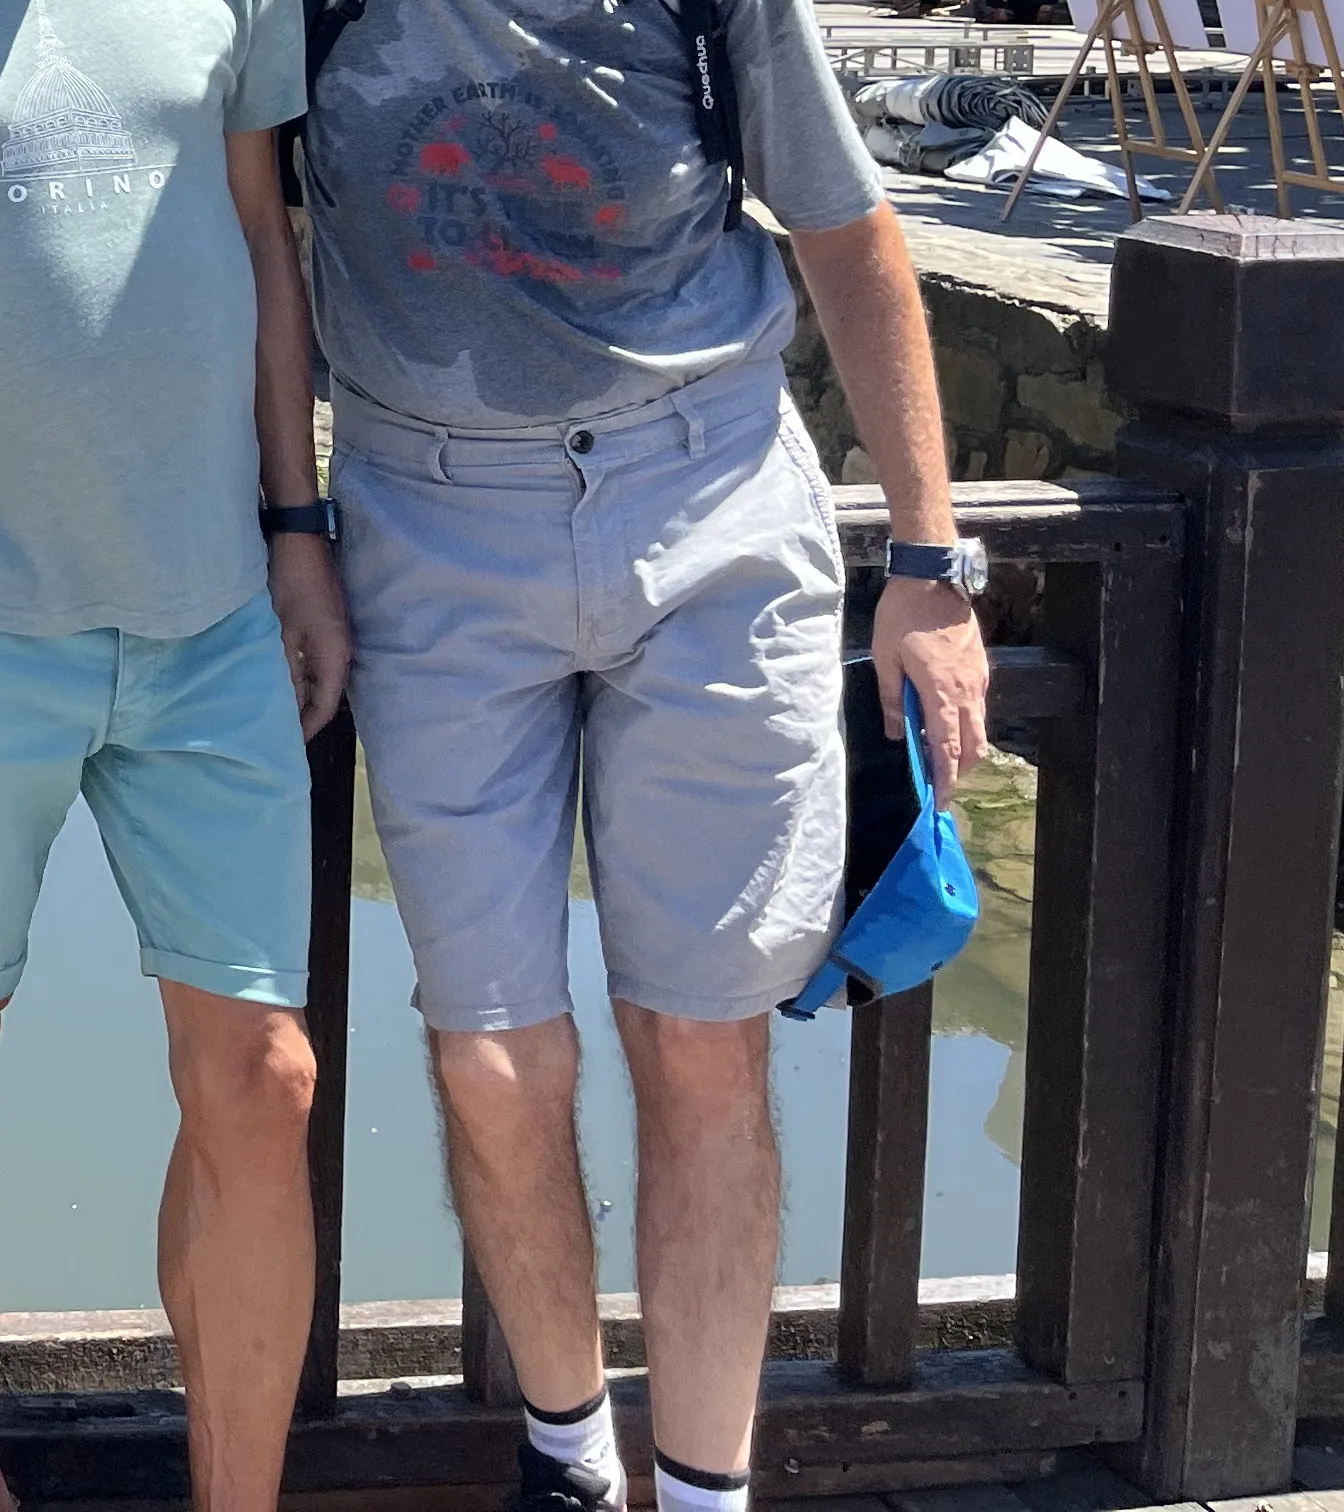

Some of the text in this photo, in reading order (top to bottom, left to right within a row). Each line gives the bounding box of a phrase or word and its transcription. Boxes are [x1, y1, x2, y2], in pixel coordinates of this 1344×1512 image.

[695, 35, 714, 110] Quechua
[452, 82, 518, 105] EARTH
[41, 201, 109, 215] ITALIA
